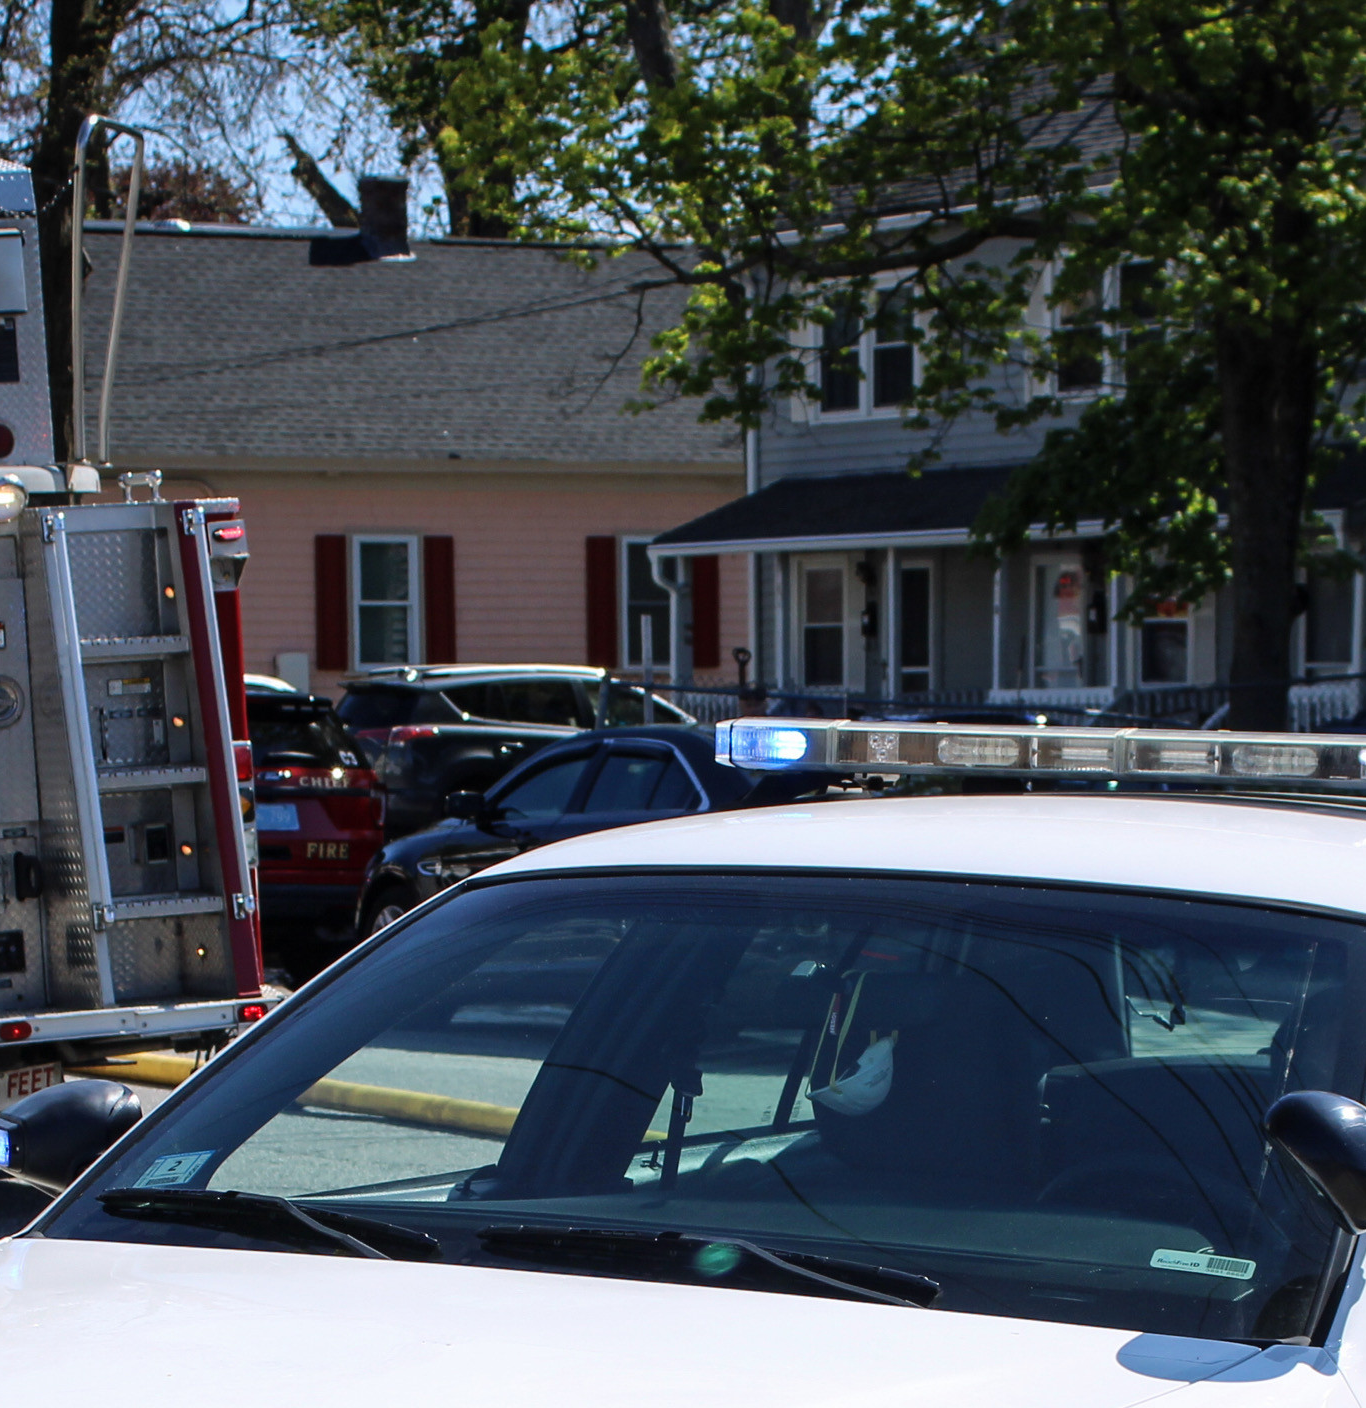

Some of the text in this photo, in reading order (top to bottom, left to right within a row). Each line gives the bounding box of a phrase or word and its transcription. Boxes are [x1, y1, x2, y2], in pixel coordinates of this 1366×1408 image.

[299, 775, 352, 789] CHIEF
[306, 841, 350, 859] FIRE
[6, 1066, 55, 1099] FEET
